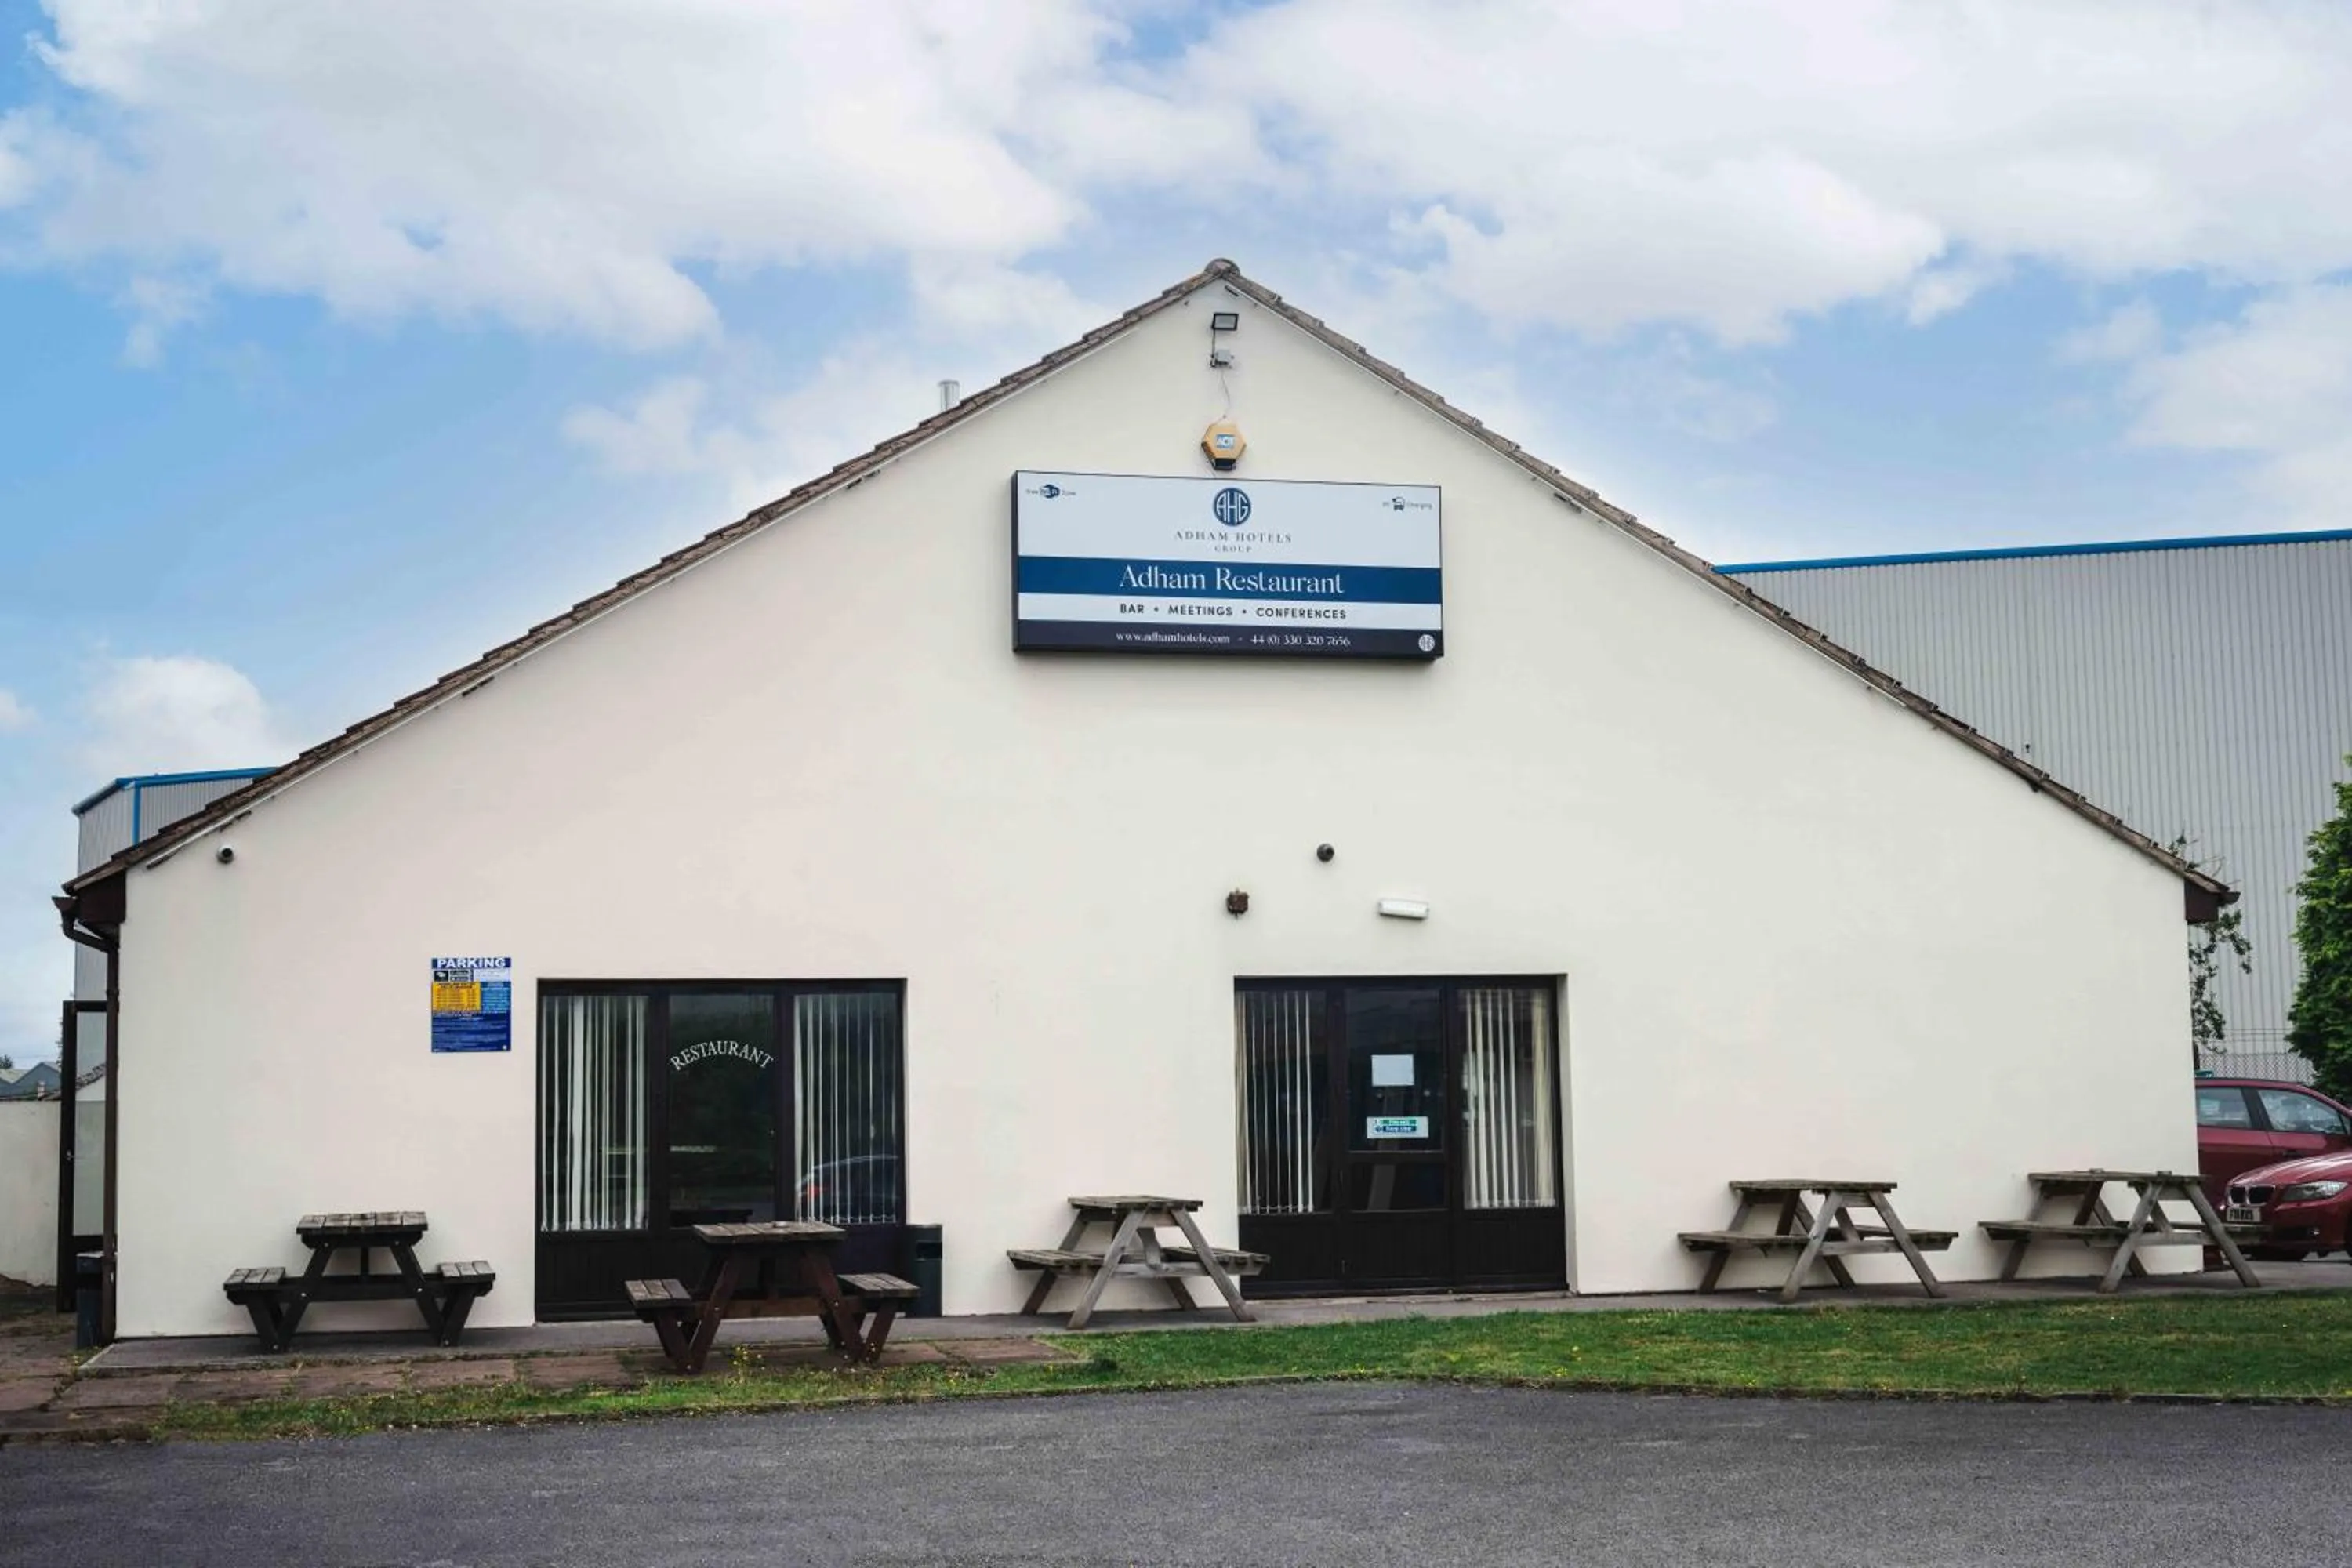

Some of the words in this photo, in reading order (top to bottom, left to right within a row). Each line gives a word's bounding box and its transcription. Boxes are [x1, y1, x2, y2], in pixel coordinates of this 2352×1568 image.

[1216, 490, 1249, 524] AHG
[1174, 531, 1228, 541] ADHAM
[1236, 532, 1292, 543] HOTELS
[1119, 564, 1206, 589] Adham
[1216, 567, 1345, 593] Restaurant
[1120, 603, 1145, 614] BAR
[1167, 604, 1234, 616] MEETINGS
[1256, 608, 1347, 619] CONFERENCES
[1116, 631, 1230, 644] www.adhamhotels.com
[437, 958, 506, 969] PARKING
[670, 1040, 774, 1071] RESTAURANT
